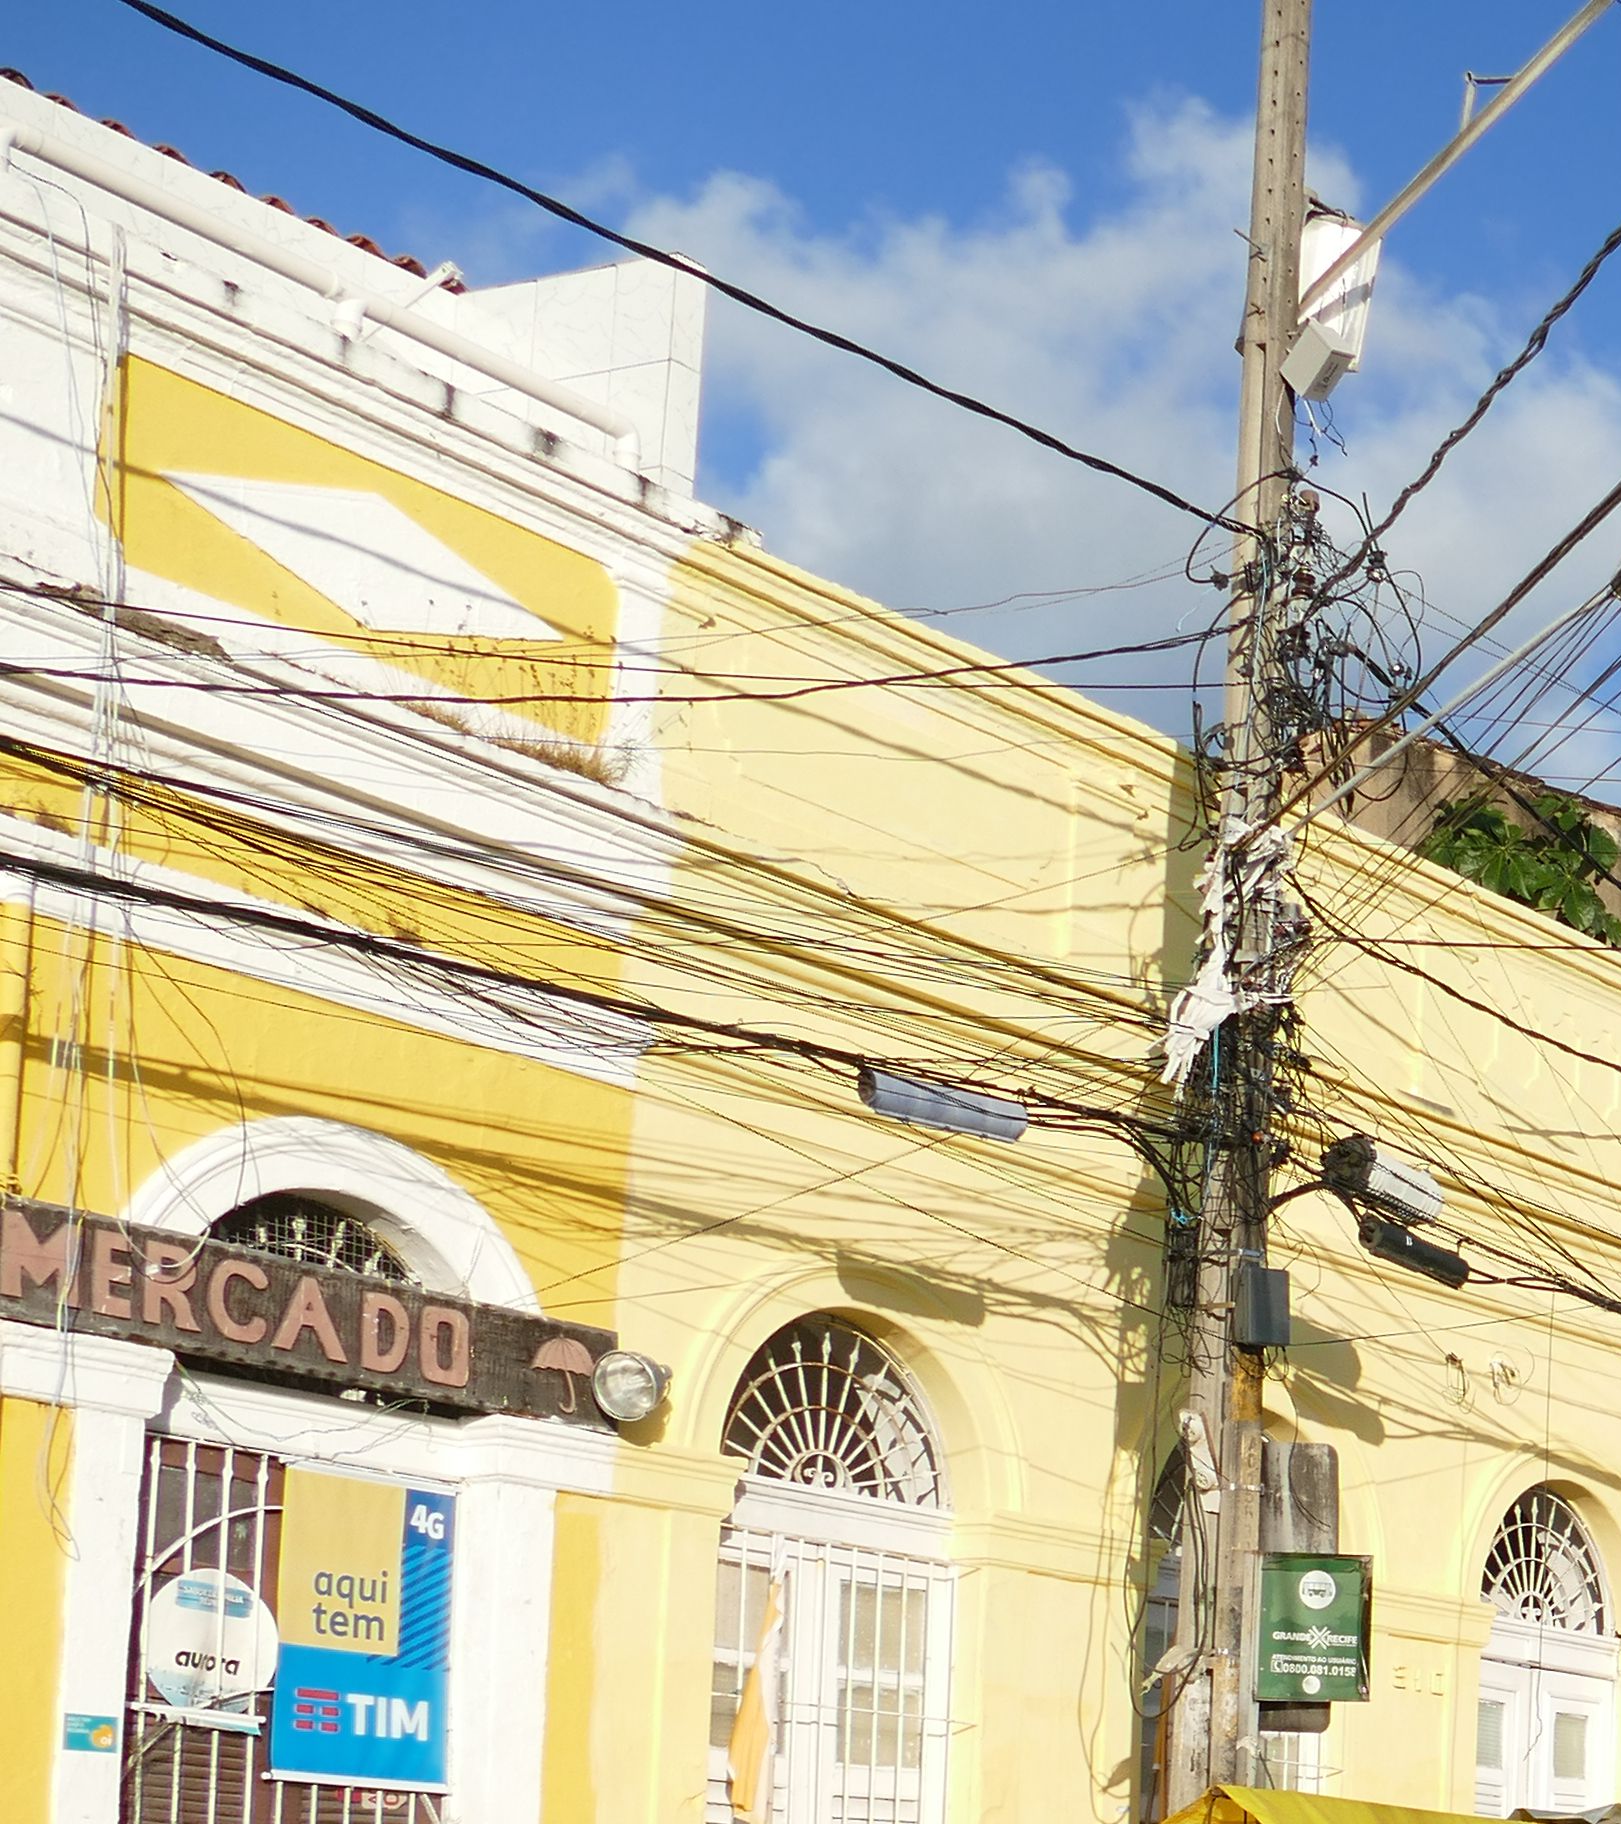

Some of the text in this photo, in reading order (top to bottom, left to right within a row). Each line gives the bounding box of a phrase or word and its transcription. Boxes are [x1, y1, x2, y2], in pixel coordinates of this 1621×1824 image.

[0, 1210, 470, 1388] MERCADO
[410, 1504, 445, 1540] 4G
[313, 1569, 389, 1610] aqui
[312, 1602, 385, 1642] tem
[1326, 1633, 1358, 1645] RECIFE
[1317, 1656, 1327, 1664] AO
[346, 1692, 430, 1742] TIM
